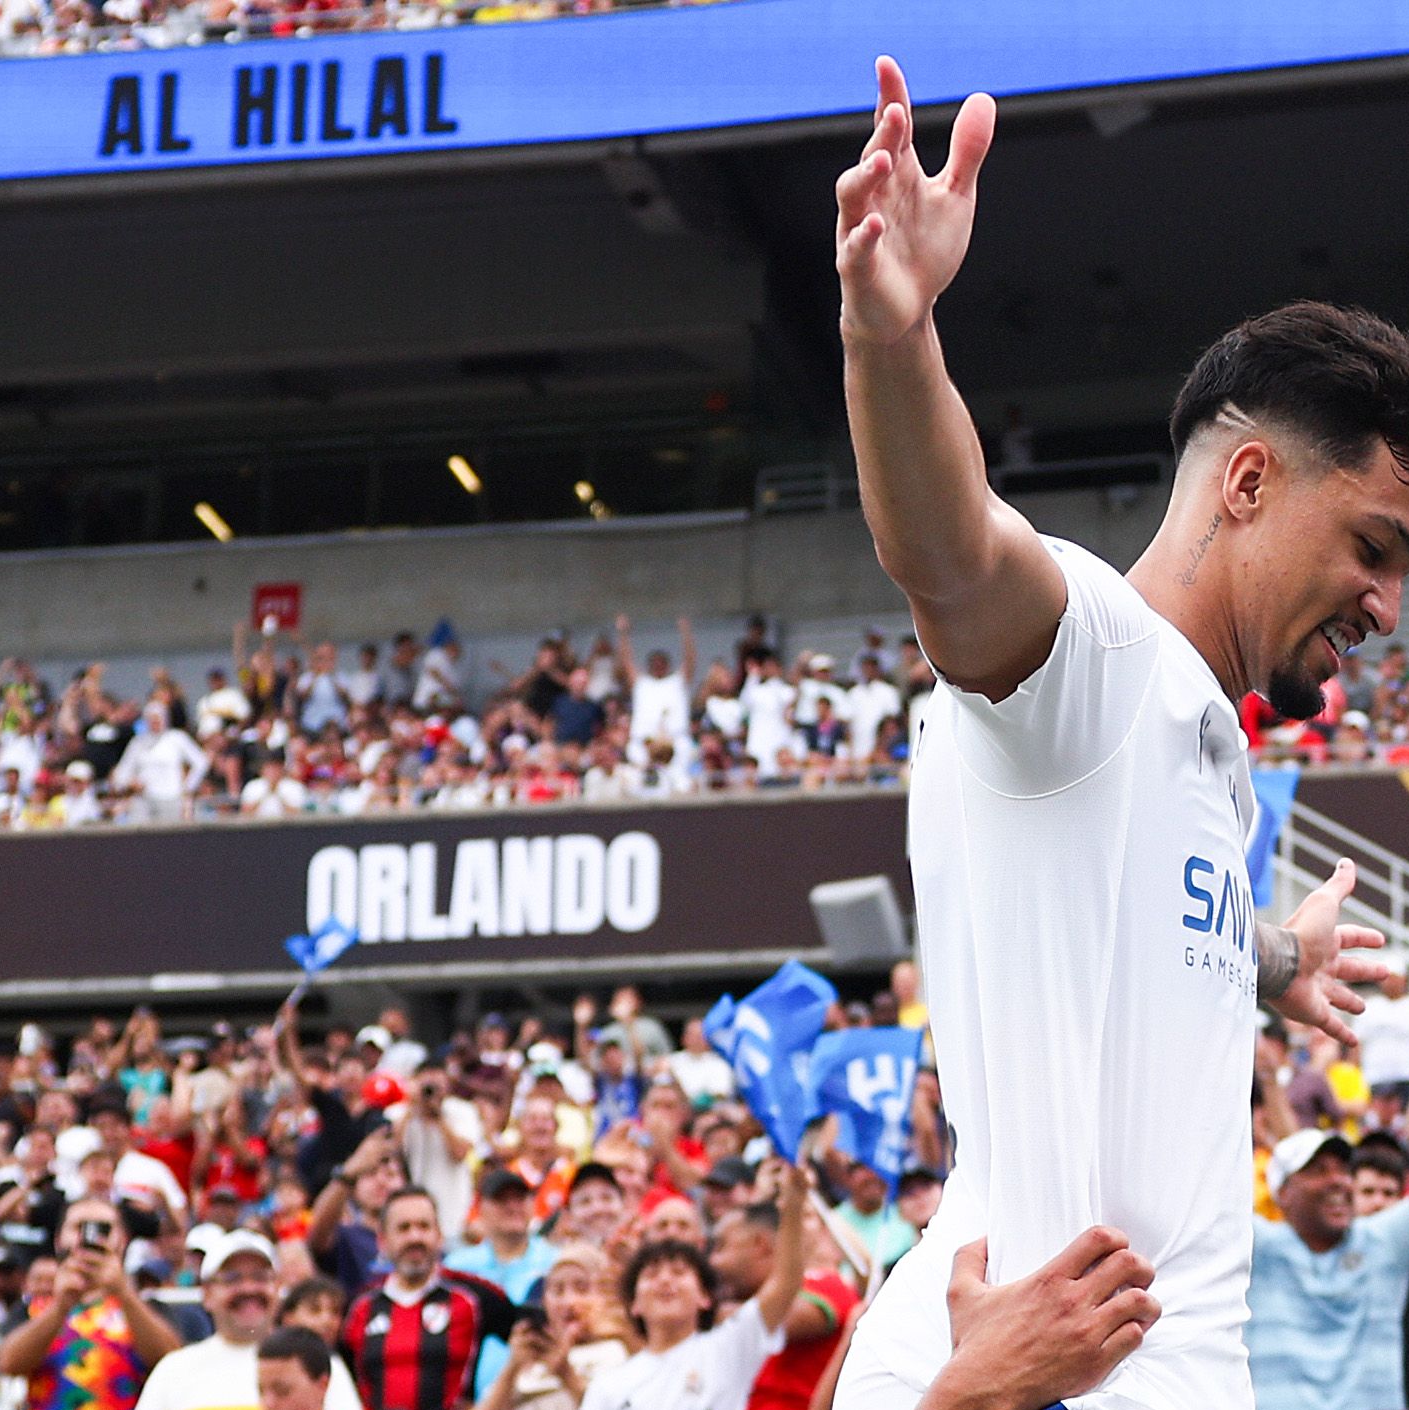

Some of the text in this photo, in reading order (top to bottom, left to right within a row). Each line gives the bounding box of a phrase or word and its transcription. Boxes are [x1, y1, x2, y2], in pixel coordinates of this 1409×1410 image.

[98, 53, 458, 156] AL HILAL
[306, 830, 661, 945] ORLANDO
[1185, 946, 1242, 988] GAMES
